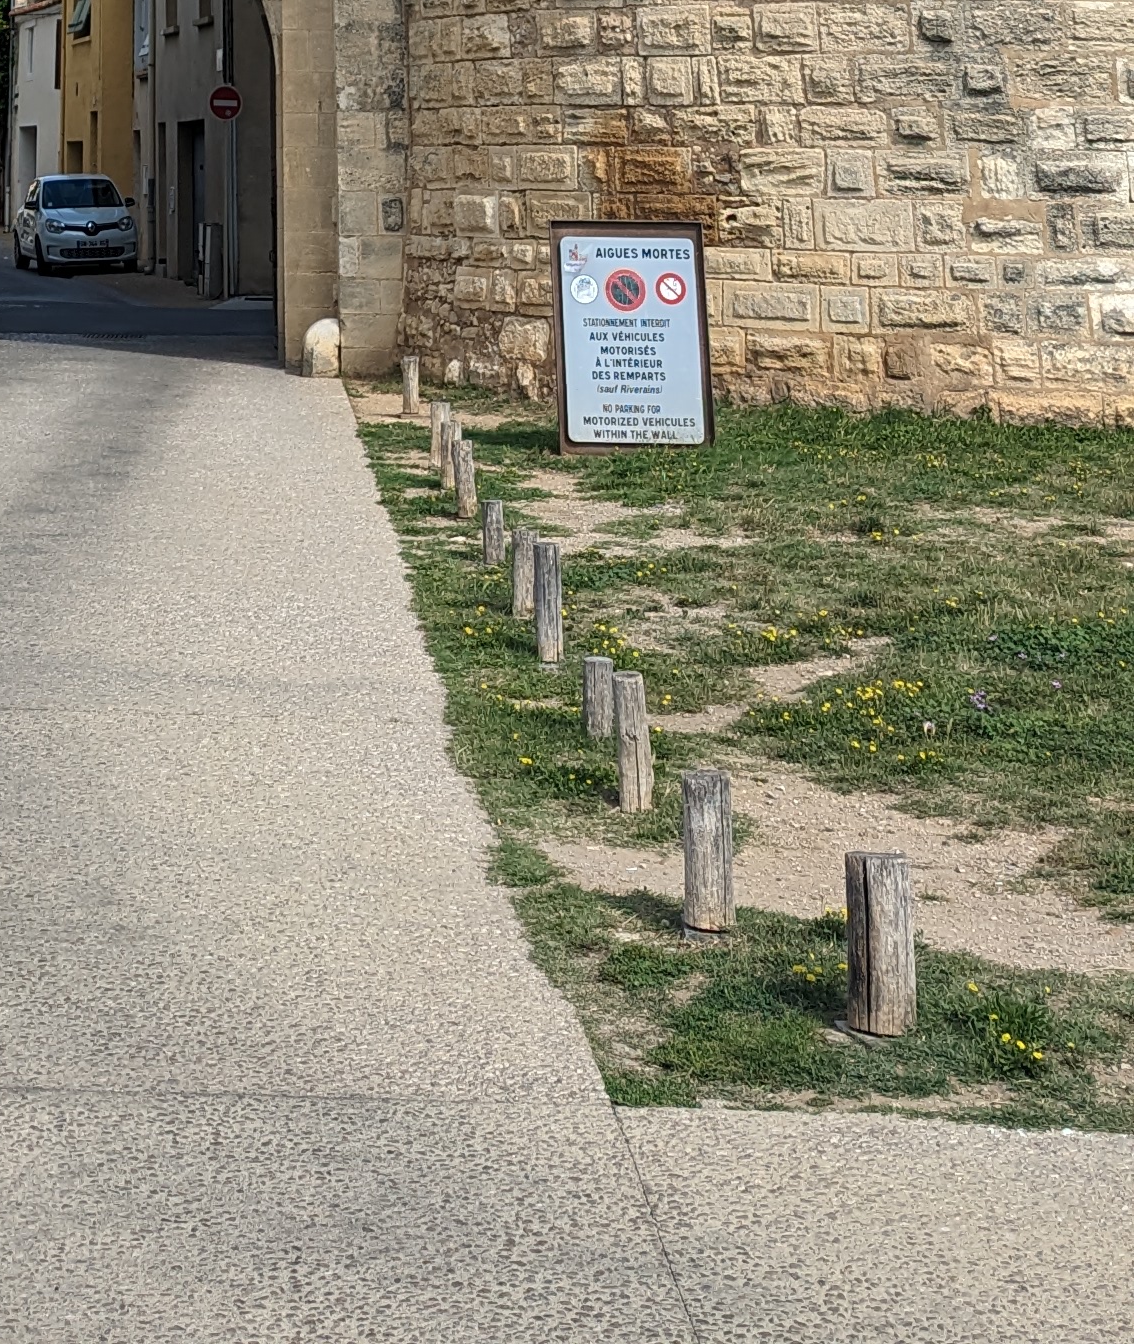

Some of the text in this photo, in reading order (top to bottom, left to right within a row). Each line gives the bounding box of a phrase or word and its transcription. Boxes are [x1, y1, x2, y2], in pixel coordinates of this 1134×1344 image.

[595, 247, 691, 260] AIGUES MORTES
[582, 317, 670, 328] STATIONNEMENT INTERDIT
[589, 330, 665, 342] AUX VÉHICULES
[600, 344, 657, 356] MOTORISÉS
[595, 356, 663, 368] À L'INTÉRIEUR
[591, 370, 666, 381] DES REMPARTS
[596, 384, 663, 394] (sauf Riverains)
[602, 403, 661, 414] NO PARKING FOR
[583, 416, 696, 427] MOTORIZED VEHICULES
[593, 429, 627, 439] WITHIN
[630, 429, 649, 439] THE
